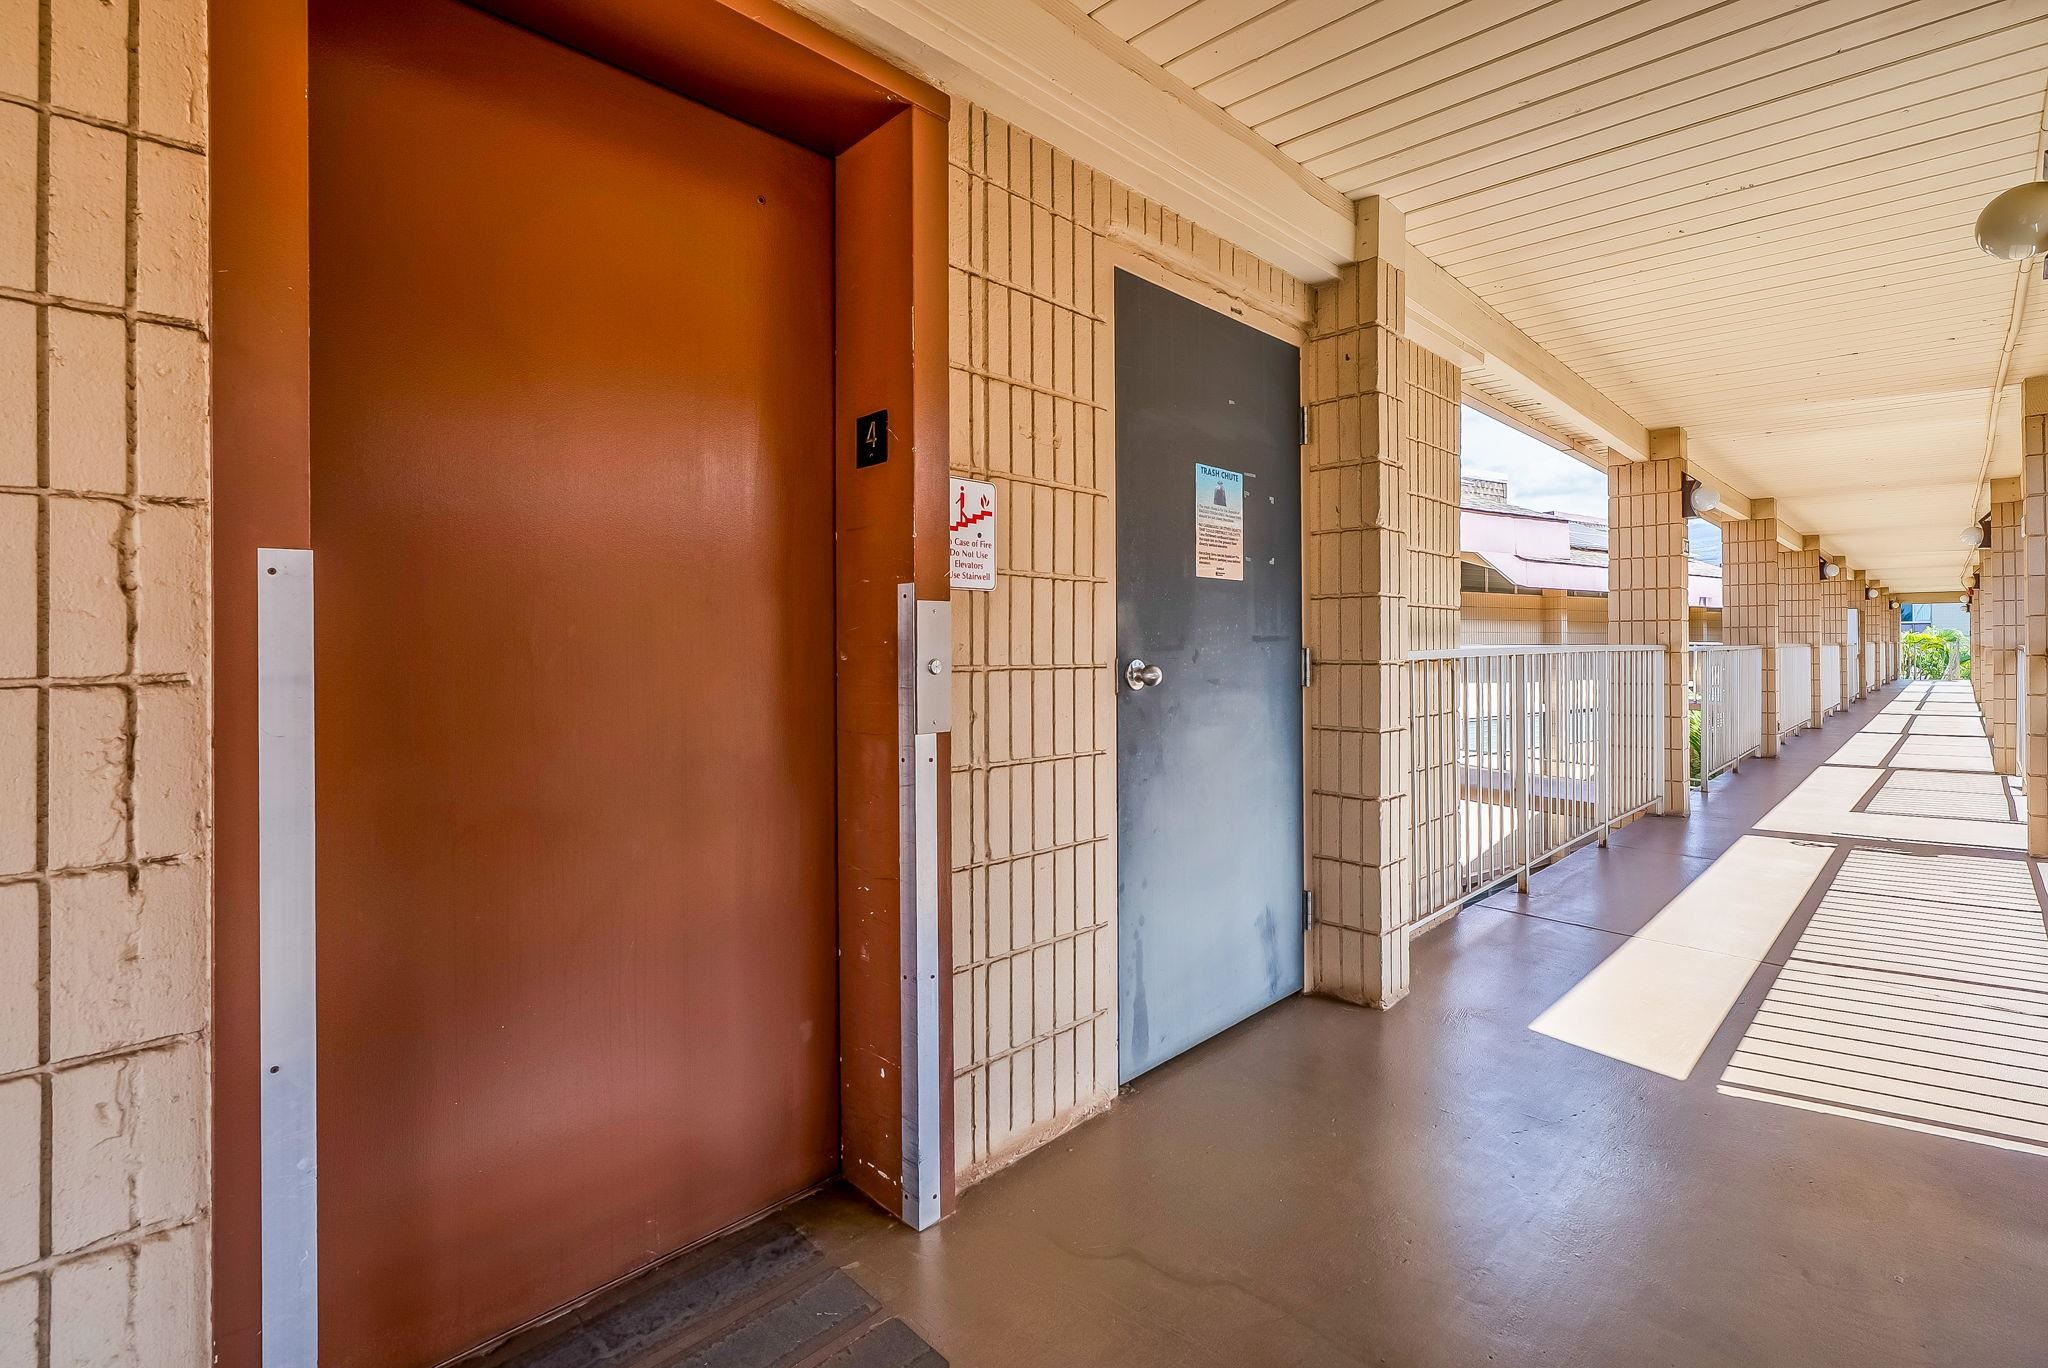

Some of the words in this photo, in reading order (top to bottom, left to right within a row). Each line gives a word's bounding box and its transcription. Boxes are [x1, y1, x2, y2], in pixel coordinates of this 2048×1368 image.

[865, 421, 878, 448] 4
[1200, 466, 1220, 478] TRASH
[1221, 471, 1239, 482] CHUTE
[955, 538, 969, 546] Case
[980, 541, 992, 549] Fire
[962, 550, 974, 558] Not
[976, 551, 988, 559] Use
[955, 560, 983, 569] Elevators
[962, 572, 990, 580] Stairwell
